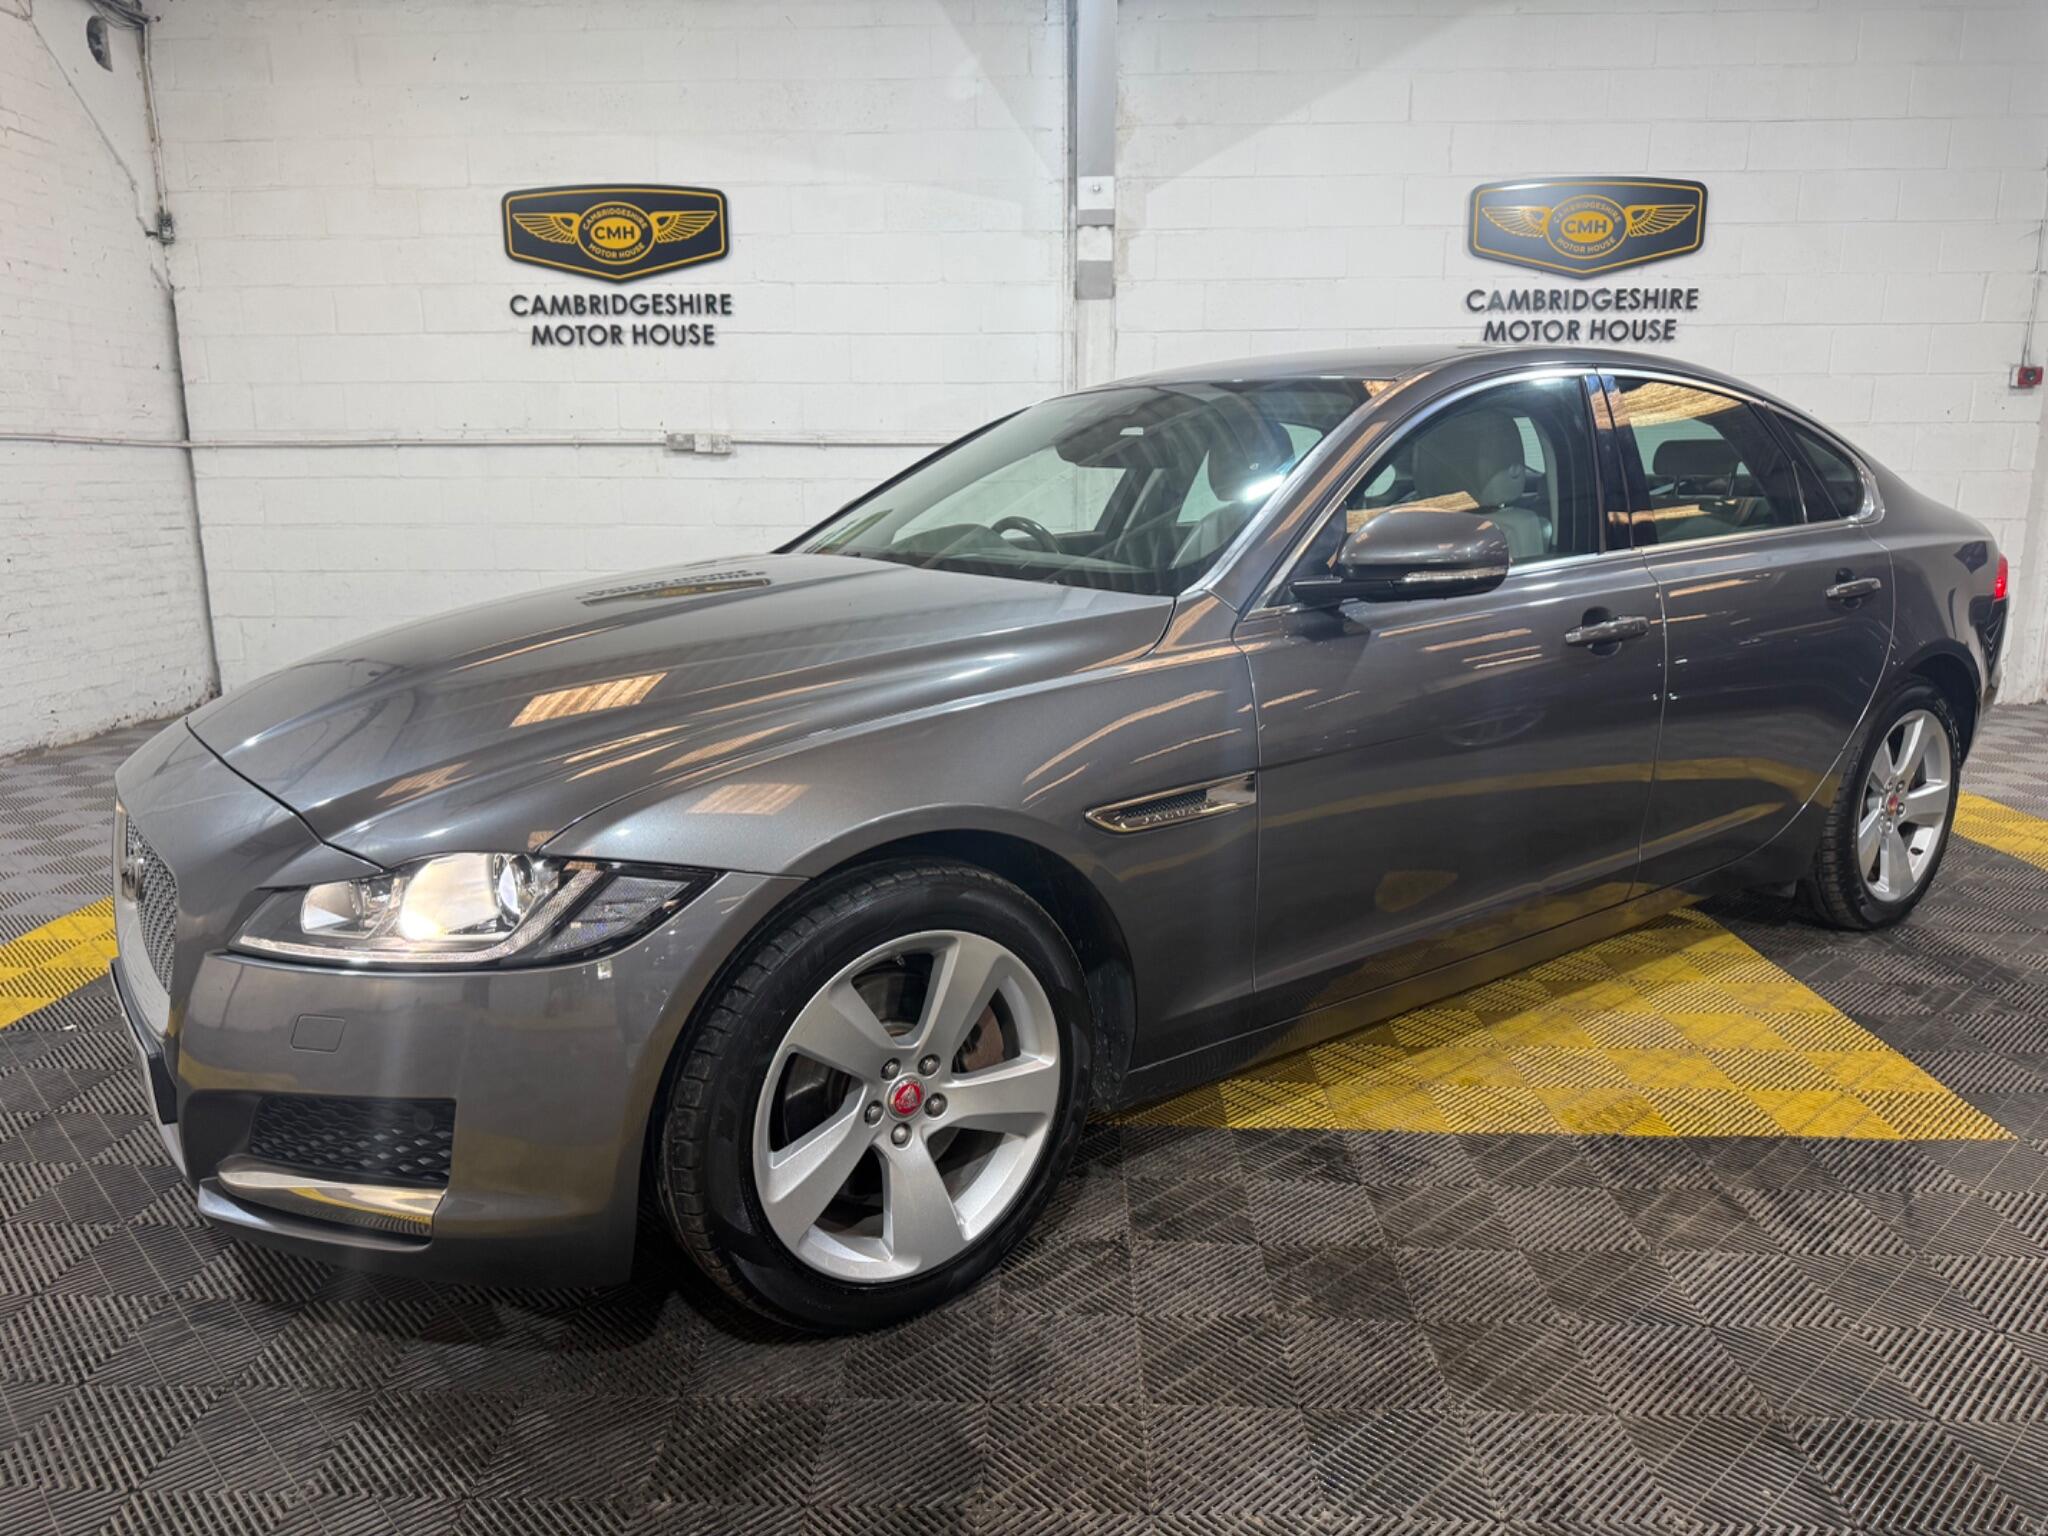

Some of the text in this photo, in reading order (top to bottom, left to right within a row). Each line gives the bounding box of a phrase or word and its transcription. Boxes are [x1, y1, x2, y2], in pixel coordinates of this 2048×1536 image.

[583, 207, 648, 230] CAMBRIDGESHIRE
[1565, 219, 1607, 234] CMH
[594, 225, 635, 240] CMH
[588, 242, 645, 259] MOTOR HOUSE
[1556, 236, 1615, 252] MOTOR HOUSE
[510, 293, 733, 316] CAMBRIDGESHIRE
[1466, 287, 1699, 311] CAMBRIDGESHIRE
[532, 324, 715, 345] MOTOR HOUSE
[1484, 319, 1677, 341] MOTOR HOUSE
